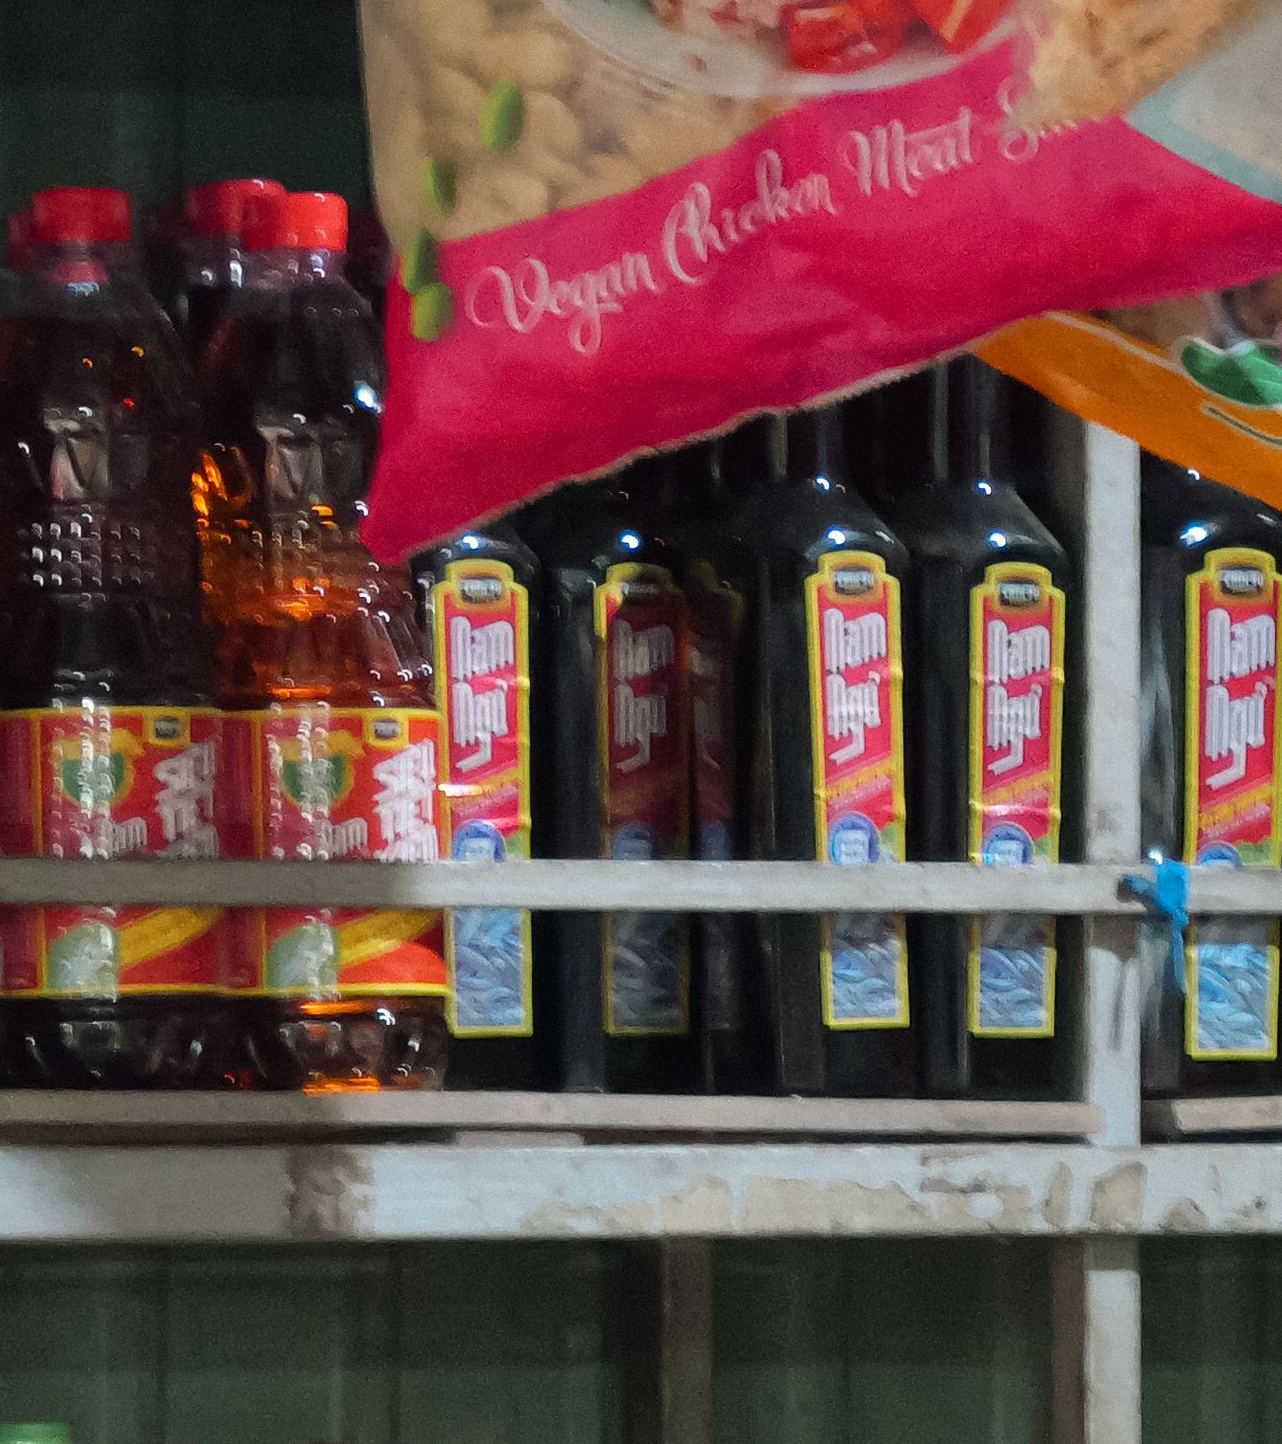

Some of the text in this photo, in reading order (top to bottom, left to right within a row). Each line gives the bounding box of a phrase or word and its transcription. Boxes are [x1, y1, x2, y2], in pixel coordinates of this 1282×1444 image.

[465, 252, 655, 354] Vegan
[660, 149, 834, 284] Chicken
[843, 106, 973, 200] Meat
